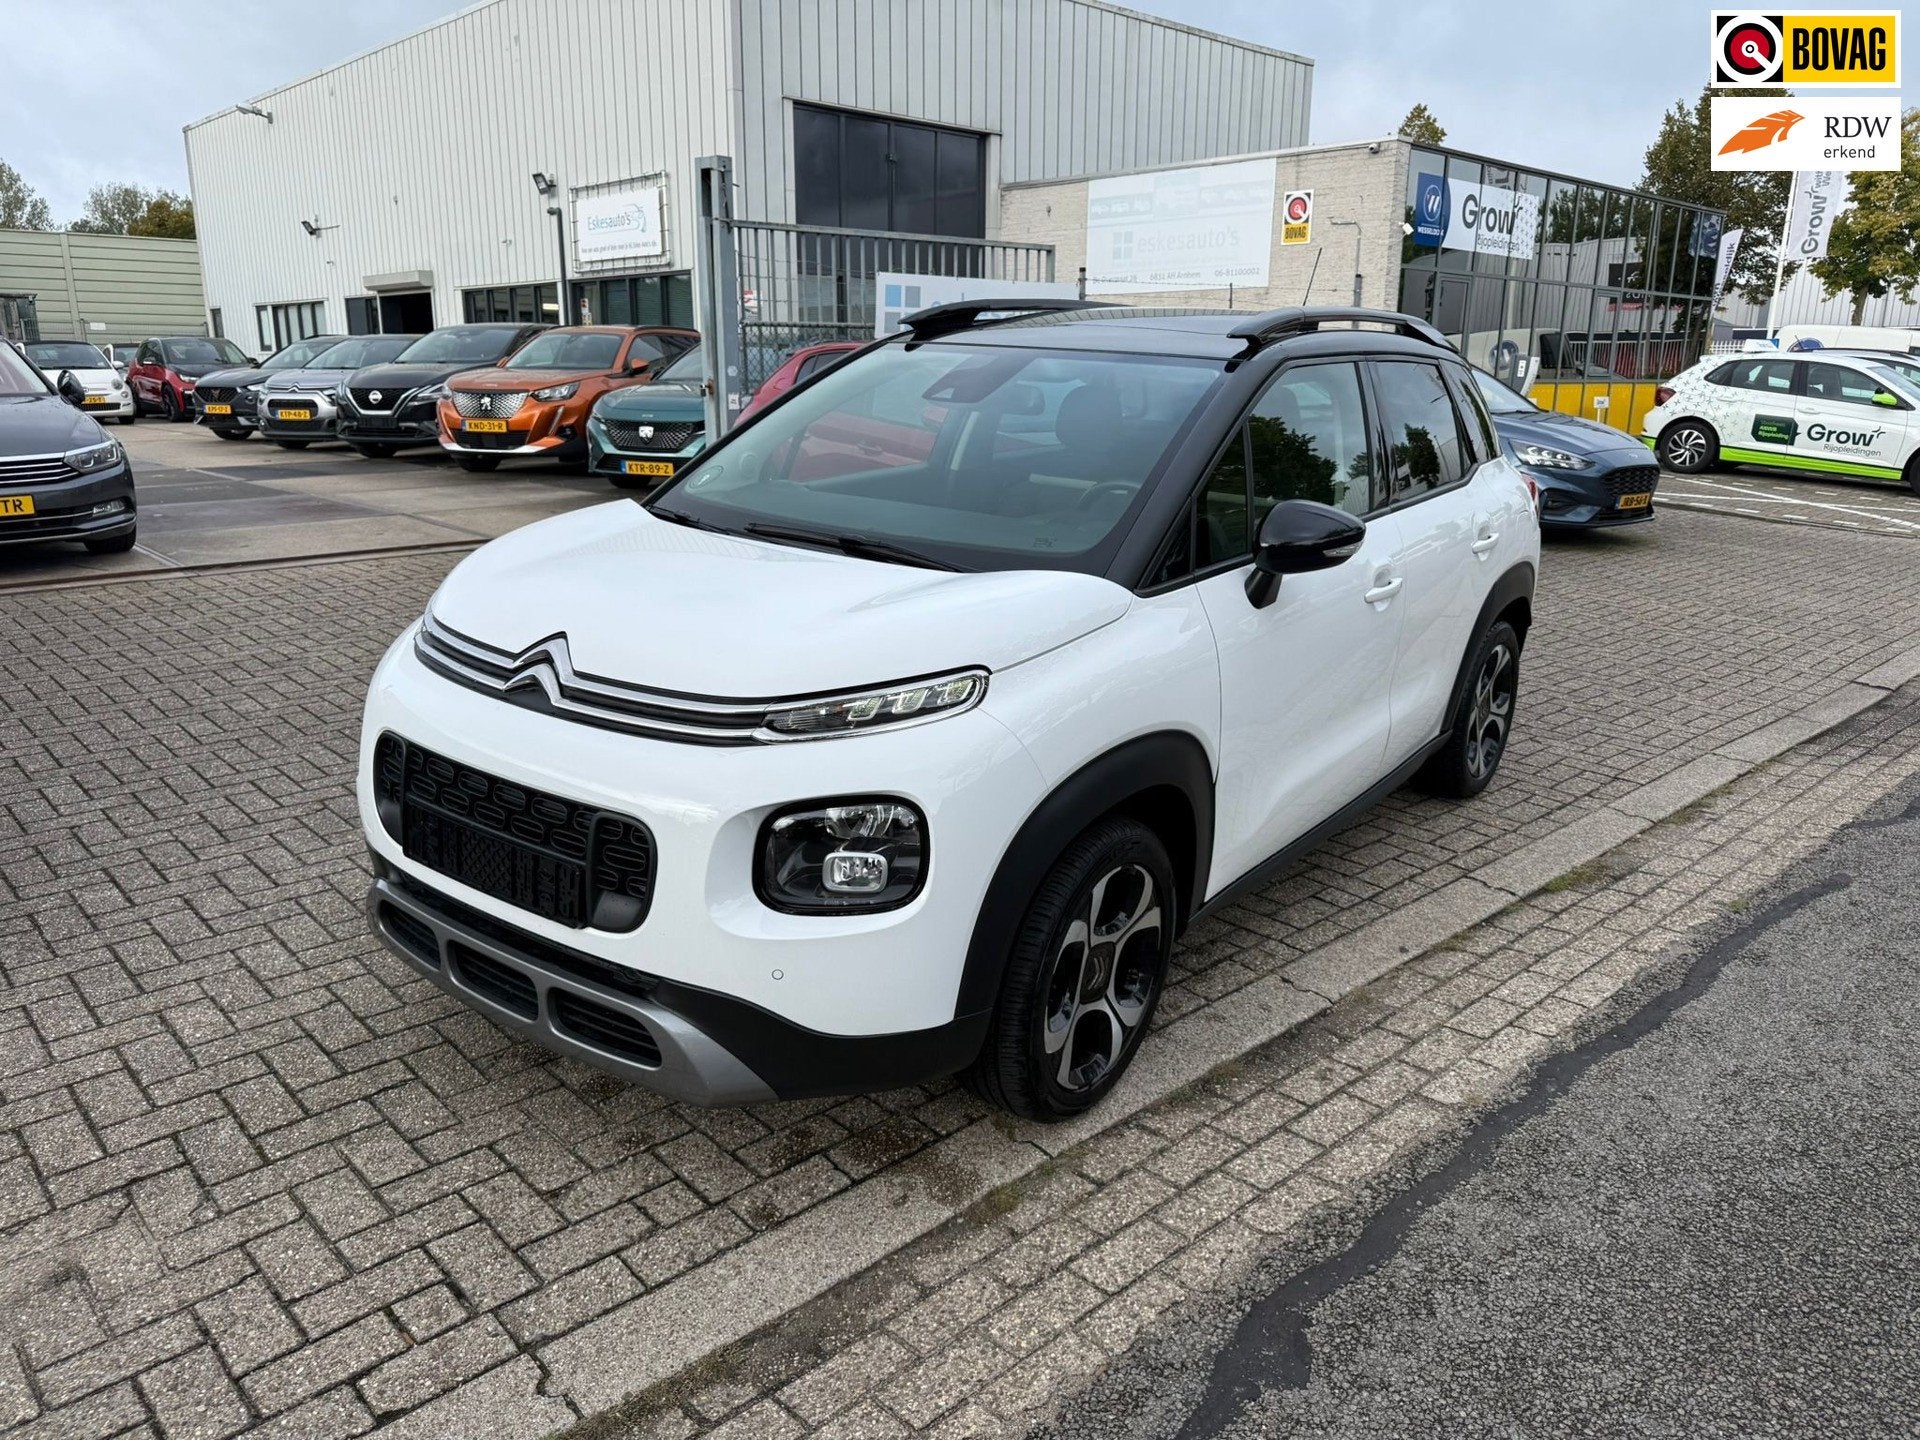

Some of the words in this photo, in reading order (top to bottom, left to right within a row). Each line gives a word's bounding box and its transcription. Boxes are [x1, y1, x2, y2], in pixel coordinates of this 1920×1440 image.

[1462, 194, 1516, 235] Grow
[1285, 226, 1307, 239] BOVAG
[1801, 195, 1827, 254] Grow
[1137, 226, 1240, 252] eskesauto's
[468, 421, 503, 431] KND-31-R
[1807, 423, 1875, 447] Grow
[1823, 443, 1881, 457] Rijopleidingen
[628, 462, 670, 474] KTR-89-Z
